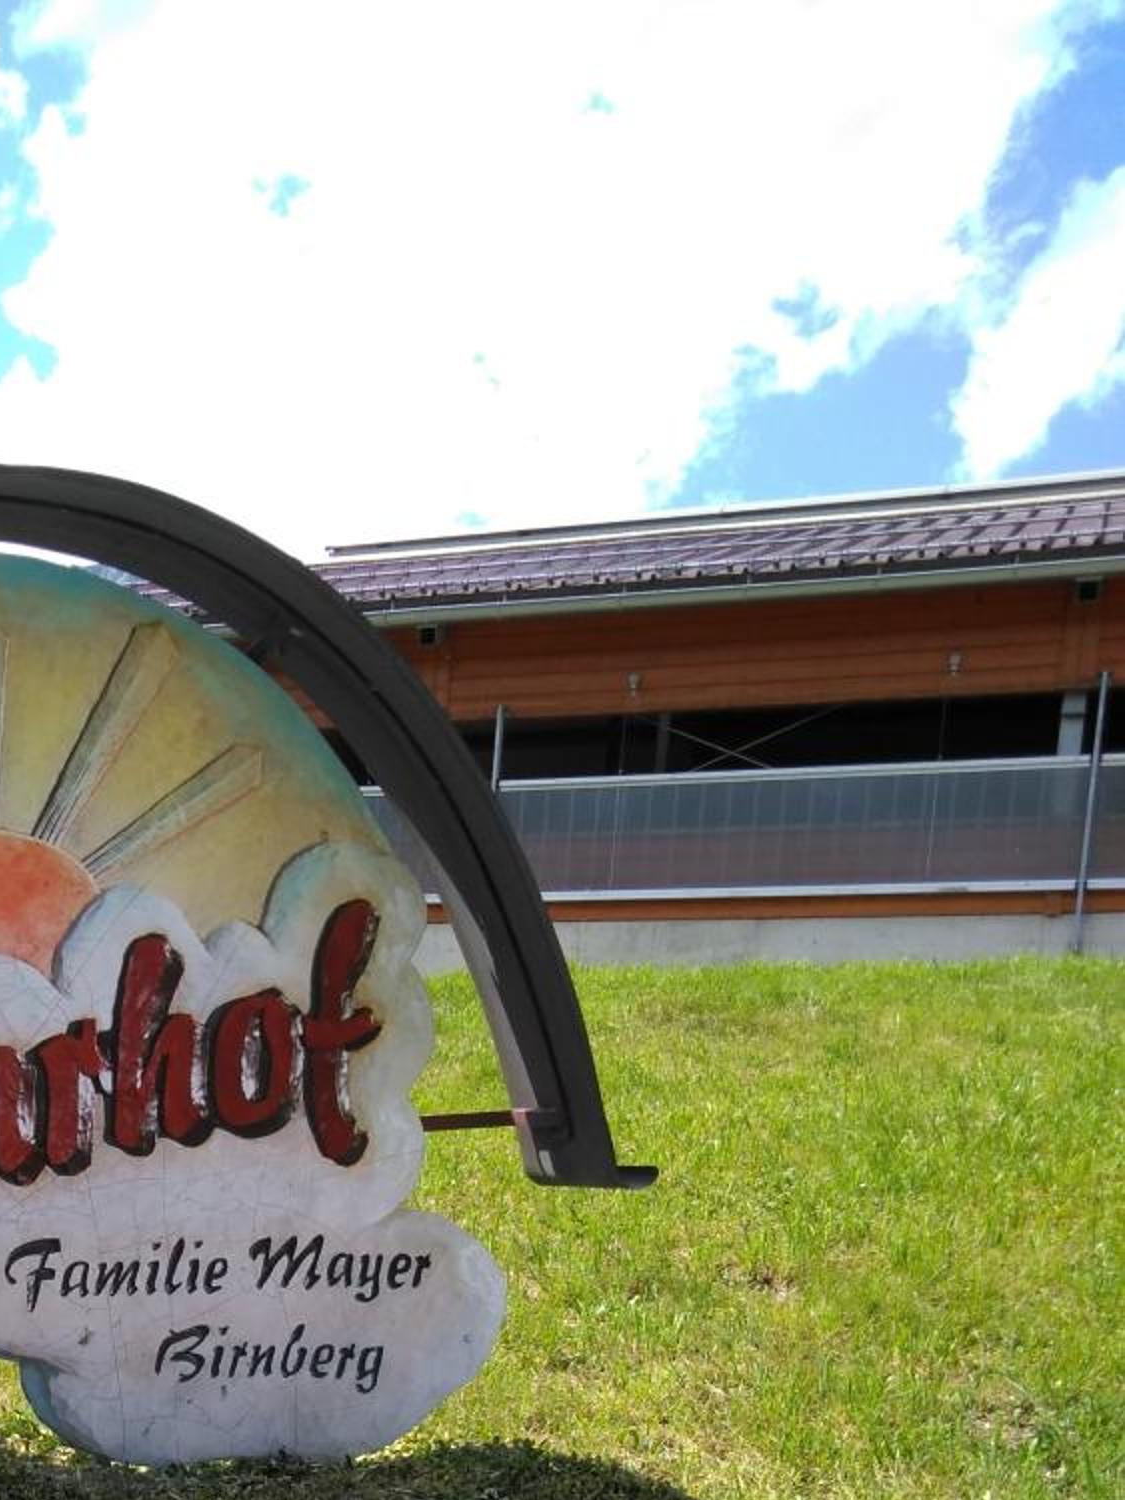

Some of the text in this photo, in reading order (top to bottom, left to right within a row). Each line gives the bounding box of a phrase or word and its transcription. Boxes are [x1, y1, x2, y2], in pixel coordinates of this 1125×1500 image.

[4, 1235, 432, 1312] Familie Mayer
[154, 1324, 385, 1393] Birnberg
